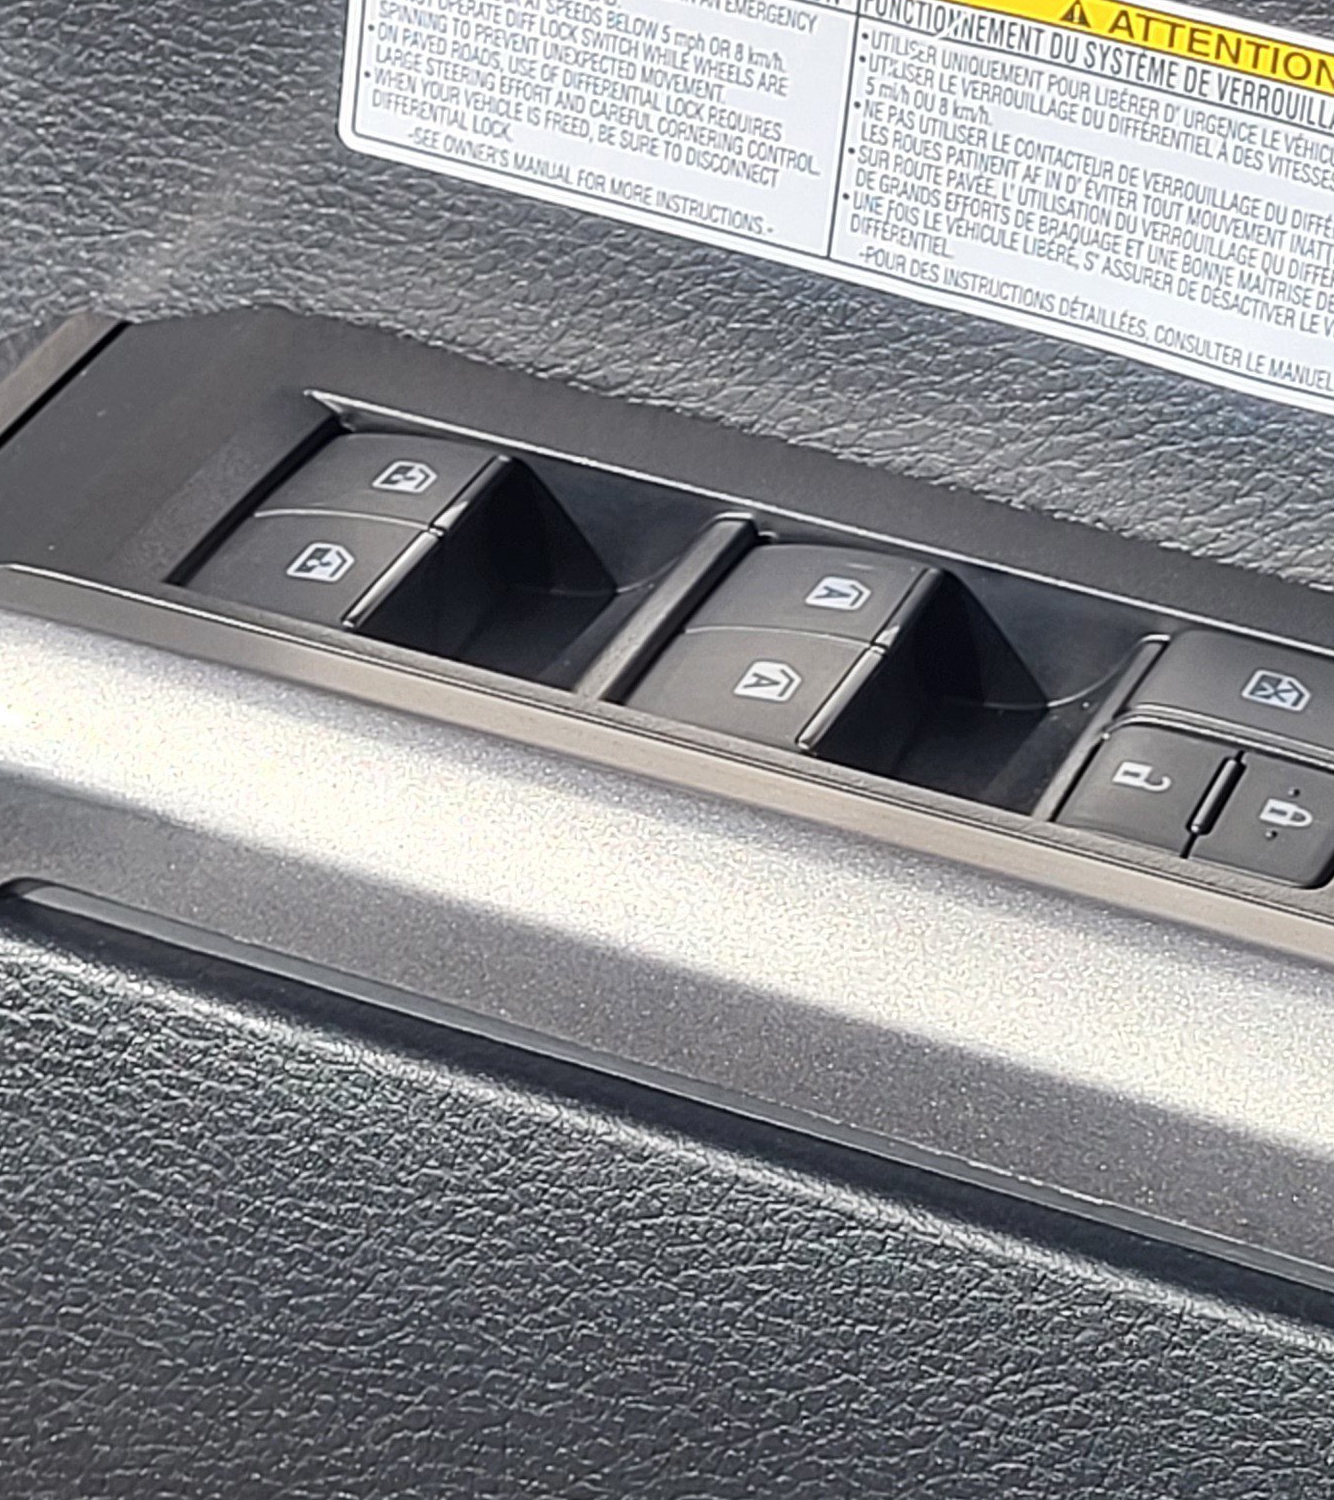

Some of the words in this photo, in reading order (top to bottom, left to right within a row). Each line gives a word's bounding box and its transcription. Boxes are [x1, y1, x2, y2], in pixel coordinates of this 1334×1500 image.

[377, 20, 398, 44] ON
[401, 27, 447, 56] PAVED
[507, 54, 538, 80] USE
[539, 62, 560, 83] OF
[561, 67, 661, 112] DIFFERENTIAL
[664, 94, 705, 122] LOCK
[706, 104, 782, 142] REQUIRES
[451, 16, 471, 40] TO
[473, 22, 540, 56] PREVENT
[542, 40, 637, 81] UNEXPECTED
[505, 7, 537, 32] DIFF
[538, 15, 579, 44] LOCK
[580, 26, 639, 59] SWITCH
[642, 41, 690, 72] WHILE
[692, 54, 755, 88] WHEELS
[756, 71, 788, 97] ARE
[605, 9, 659, 40] BELOW
[708, 35, 731, 59] OR
[1048, 31, 1079, 65] DU
[1181, 64, 1211, 98] DE
[371, 87, 468, 131] DIFFERENTIAL
[373, 66, 417, 94] WHEN
[420, 77, 460, 105] YOUR
[463, 88, 523, 122] VEHICLE
[526, 105, 541, 126] IS
[596, 122, 616, 146] BE
[618, 128, 659, 157] SURE
[663, 139, 682, 163] TO
[684, 145, 780, 188] DISCONNECT
[375, 43, 422, 73] LARGE
[424, 56, 496, 92] STEERING
[498, 74, 553, 105] EFFORT
[553, 89, 586, 114] AND
[588, 98, 654, 133] CAREFUL
[656, 115, 744, 156] CORNERING
[912, 88, 936, 112] OU
[937, 71, 958, 95] LE
[960, 76, 1079, 123] VERROUILLAGE
[1080, 105, 1105, 130] DU
[1231, 144, 1264, 171] DES
[940, 48, 1045, 91] UNIQUEMENT
[1046, 72, 1091, 102] POUR
[1182, 107, 1258, 145] URGENCE
[1260, 127, 1281, 151] LE
[513, 151, 573, 185] MANUAL
[576, 168, 606, 193] FOR
[609, 176, 653, 206] MORE
[856, 143, 890, 171] SUR
[892, 153, 944, 186] ROUTE
[1016, 185, 1112, 228] UTILISATION
[1114, 210, 1138, 235] DU
[1141, 217, 1259, 268] VERROUILLAGE
[860, 120, 889, 146] LES
[891, 129, 942, 162] ROUES
[945, 144, 1020, 179] PATINENT
[1142, 193, 1184, 222] TOUT
[1185, 205, 1288, 249] MOUVEMENT
[862, 98, 885, 122] NE
[886, 104, 915, 131] PAS
[918, 113, 988, 149] UTILISER
[990, 131, 1011, 154] LE
[1013, 136, 1114, 181] CONTACTEUR
[1116, 163, 1140, 188] DE
[1142, 168, 1262, 219] VERROUILLAGE
[1263, 201, 1288, 226] DU
[852, 190, 884, 216] UNE
[885, 198, 920, 227] FOIS
[922, 208, 943, 232] LE
[1100, 255, 1173, 294] ASSURER
[1176, 276, 1198, 301] DE
[1298, 310, 1320, 334] LE
[854, 166, 876, 191] DE
[878, 173, 942, 208] GRANDS
[943, 191, 1011, 225] EFFORTS
[1013, 208, 1035, 232] DE
[1037, 214, 1123, 255] BRAQUAGE
[1124, 237, 1145, 260] ET
[1146, 243, 1179, 271] UNE
[1180, 253, 1235, 287] BONNE
[908, 257, 940, 283] DES
[942, 266, 1056, 313] INSTRUCTIONS
[1153, 324, 1243, 367] CONSULTER
[1245, 351, 1266, 373] LE
[1267, 357, 1334, 392] MANUEL
